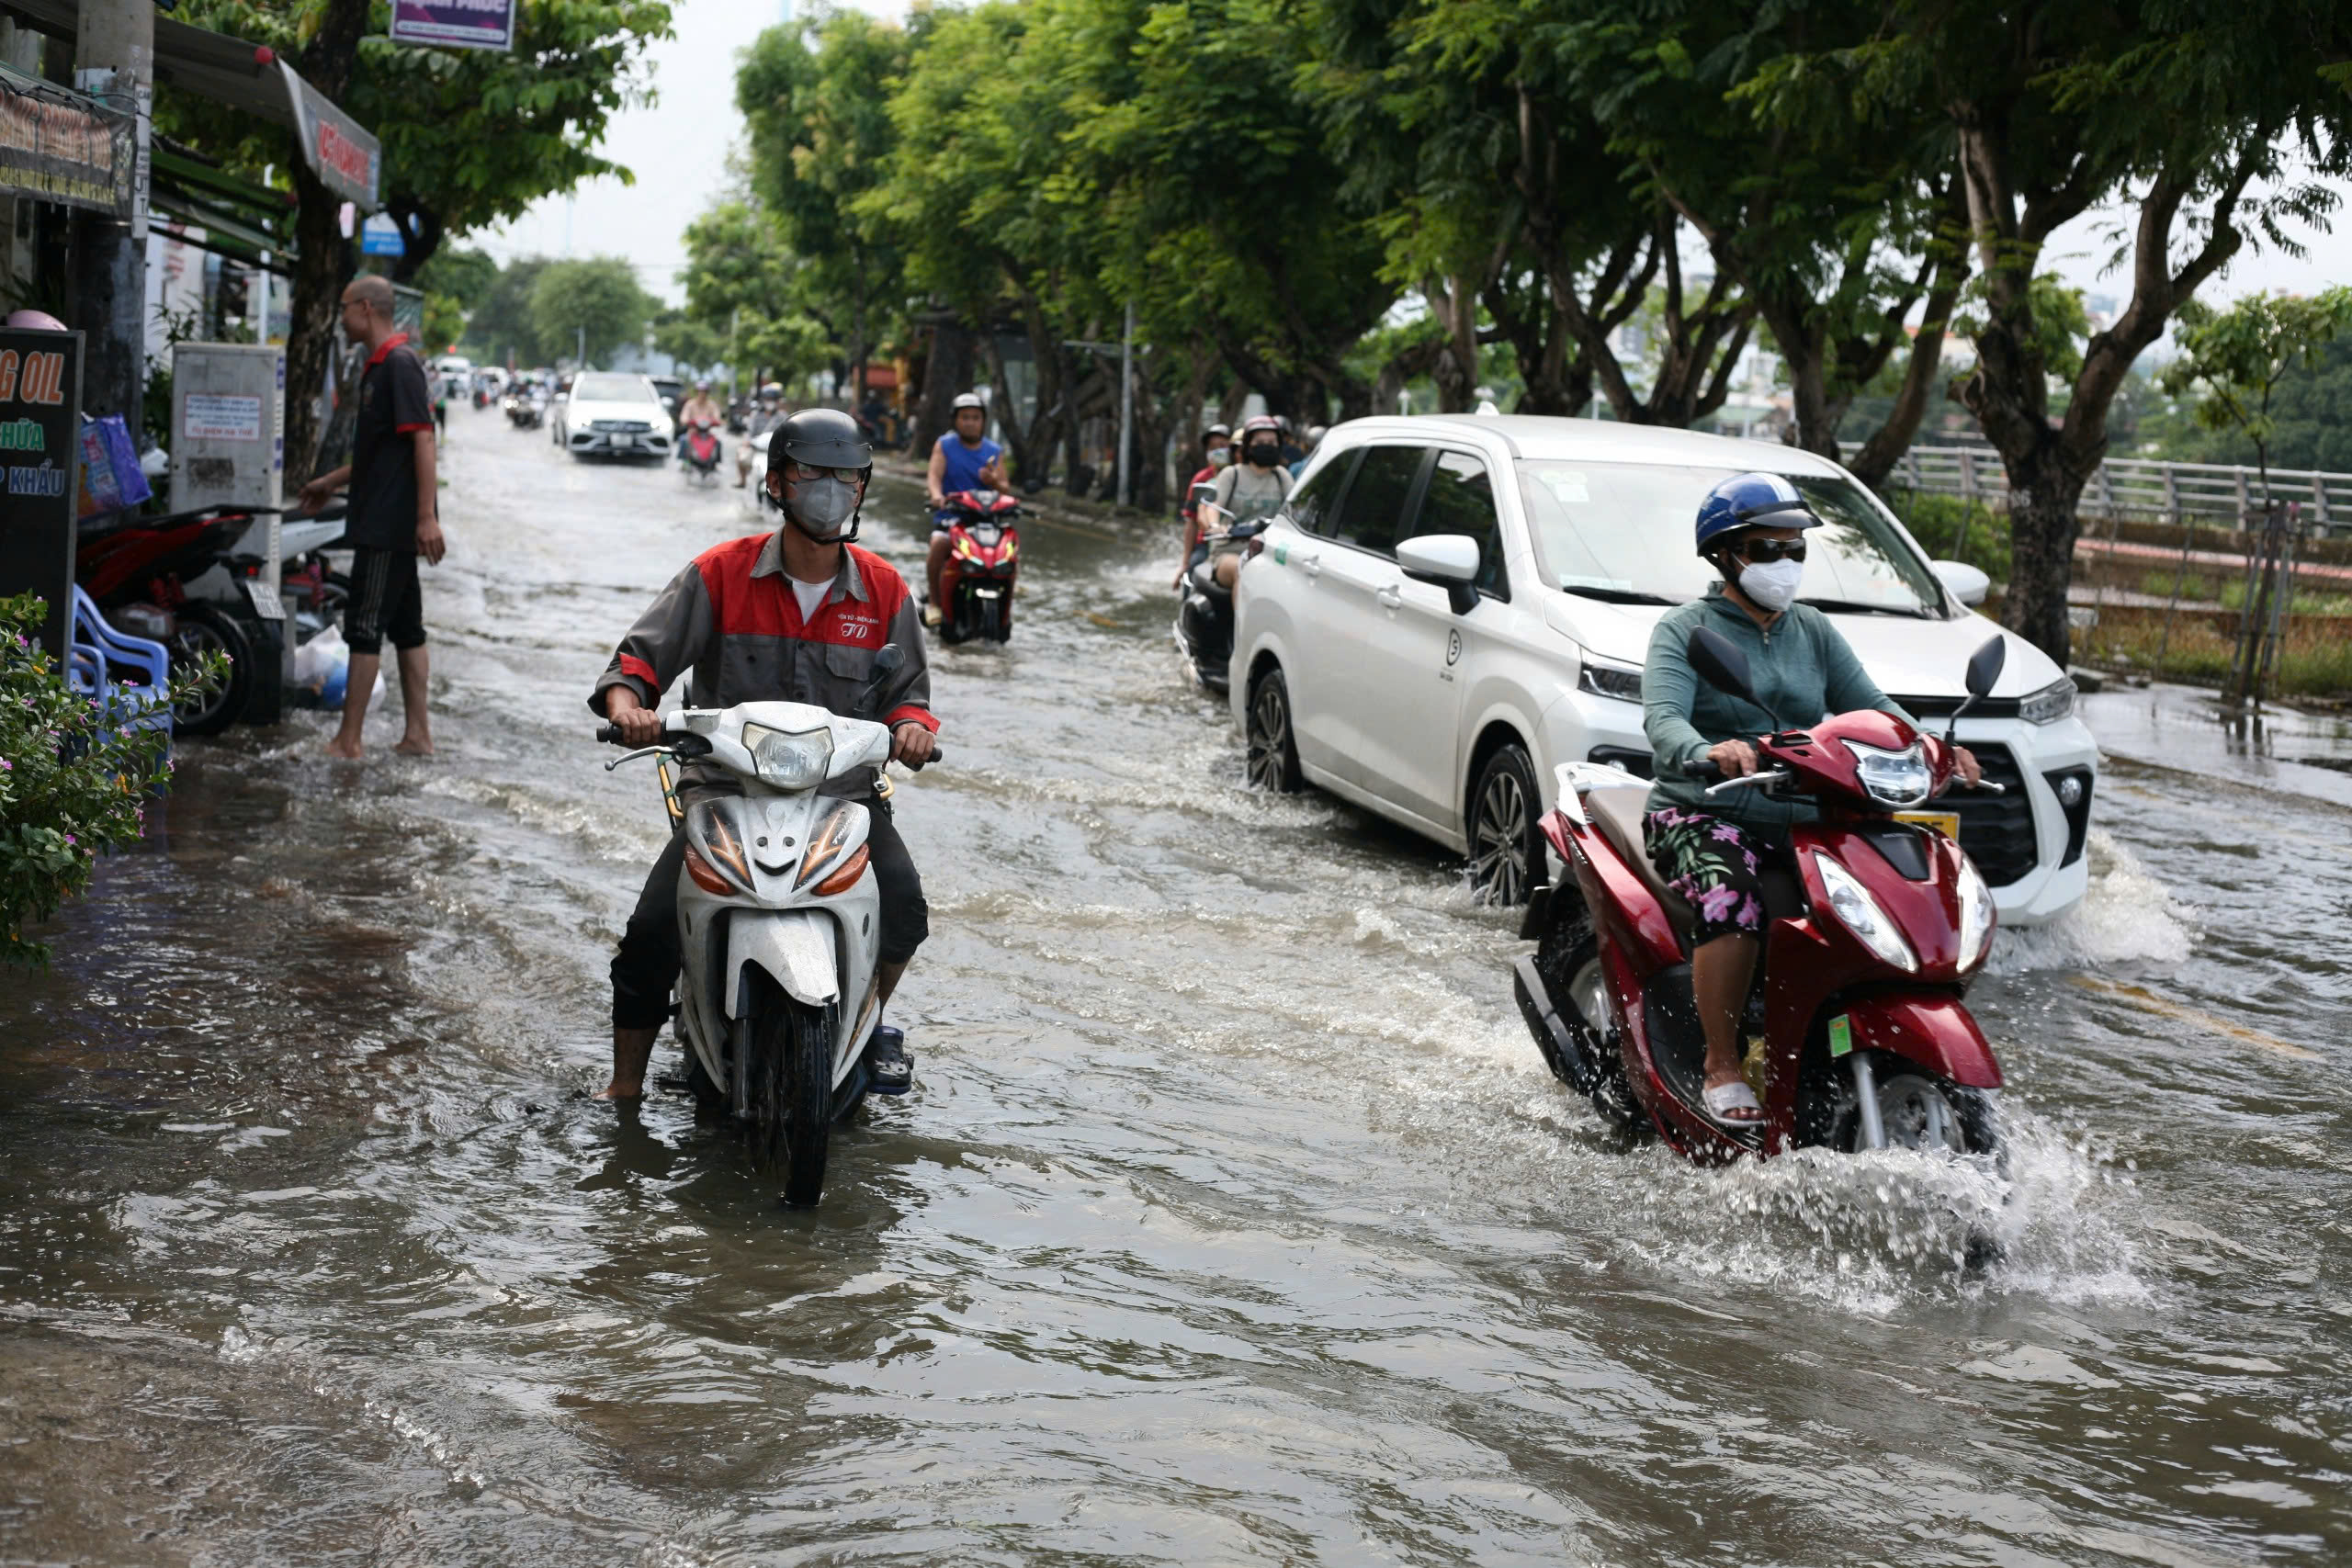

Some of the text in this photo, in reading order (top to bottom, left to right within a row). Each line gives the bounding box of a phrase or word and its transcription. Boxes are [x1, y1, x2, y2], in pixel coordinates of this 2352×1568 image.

[0, 349, 64, 405] G OIL
[0, 417, 44, 451] HỮA
[8, 458, 65, 497] KHẨU
